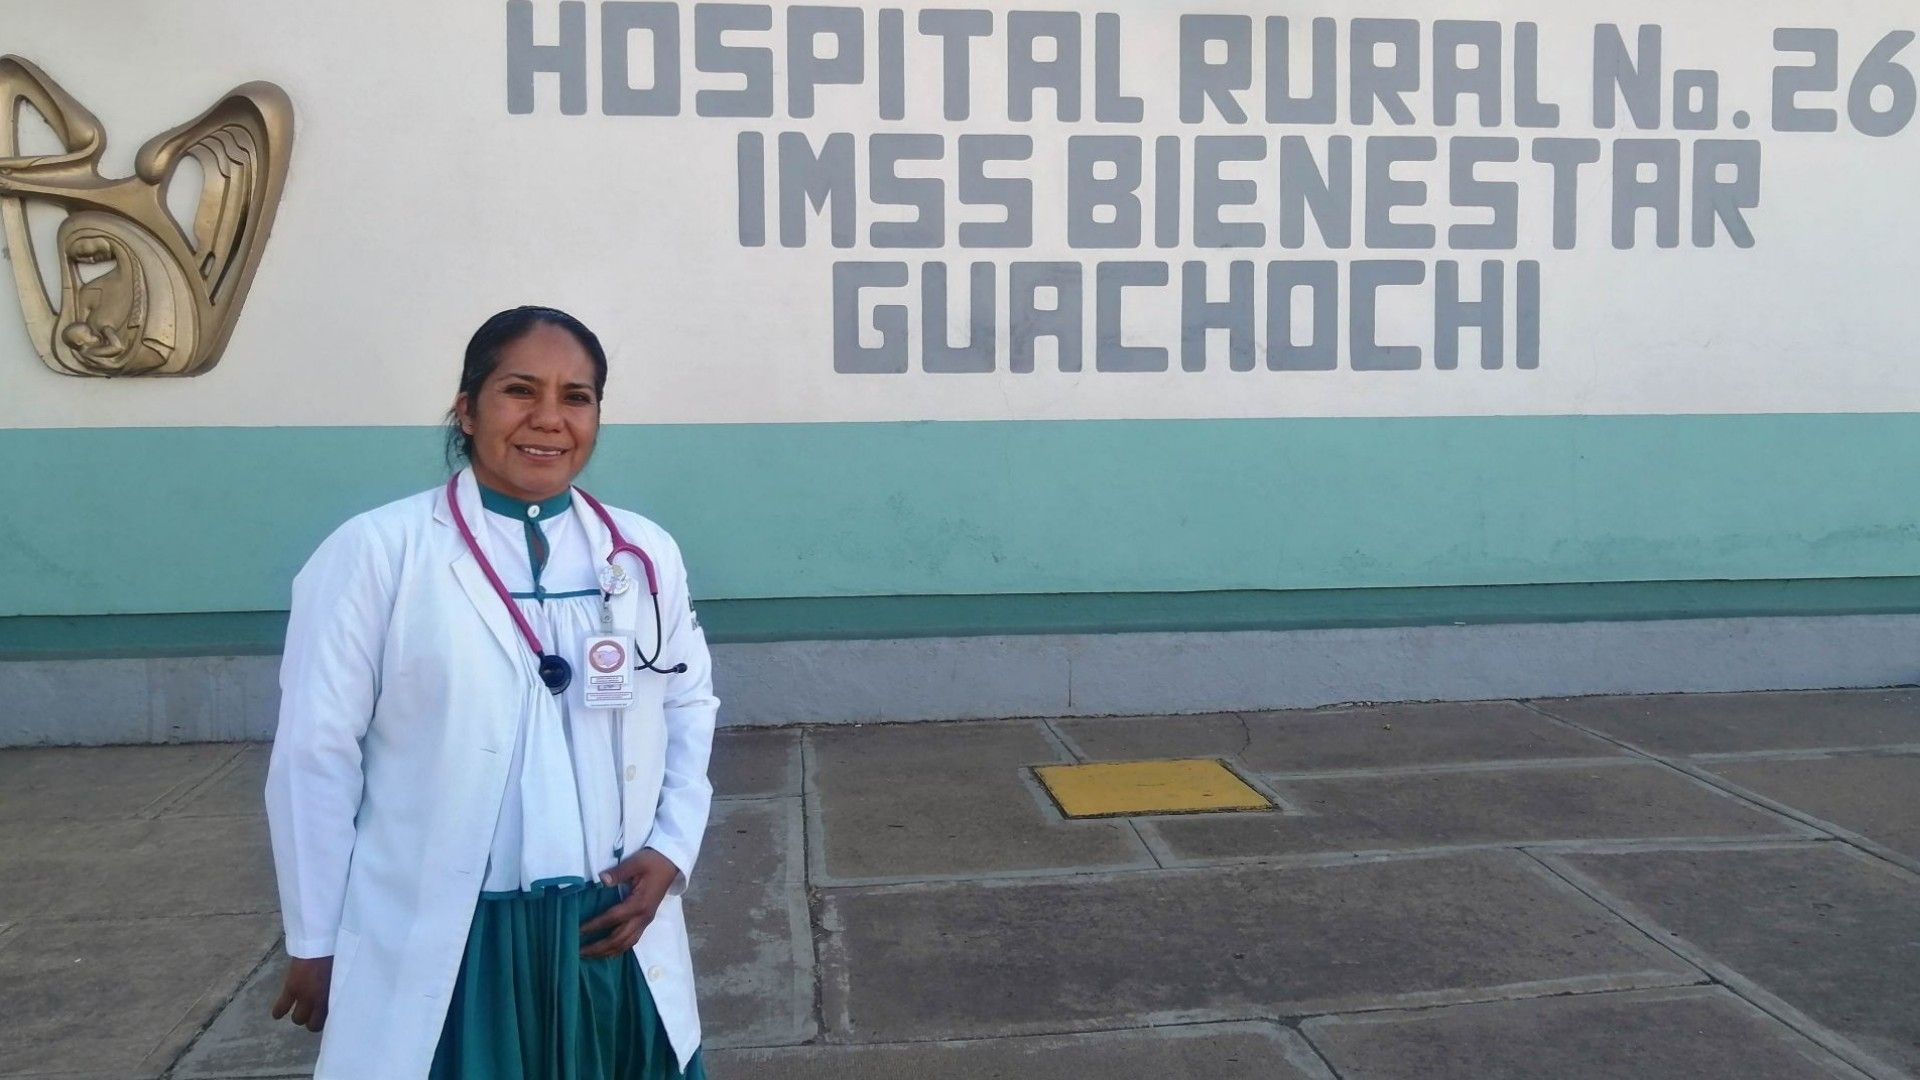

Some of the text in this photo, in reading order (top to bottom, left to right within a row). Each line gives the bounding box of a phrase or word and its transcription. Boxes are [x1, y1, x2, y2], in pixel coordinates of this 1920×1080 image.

[506, 0, 1917, 137] HOSPITAL RURAL No. 26
[737, 131, 1762, 250] IMSS BIENESTAR
[832, 260, 1541, 374] GUACHOCHI
